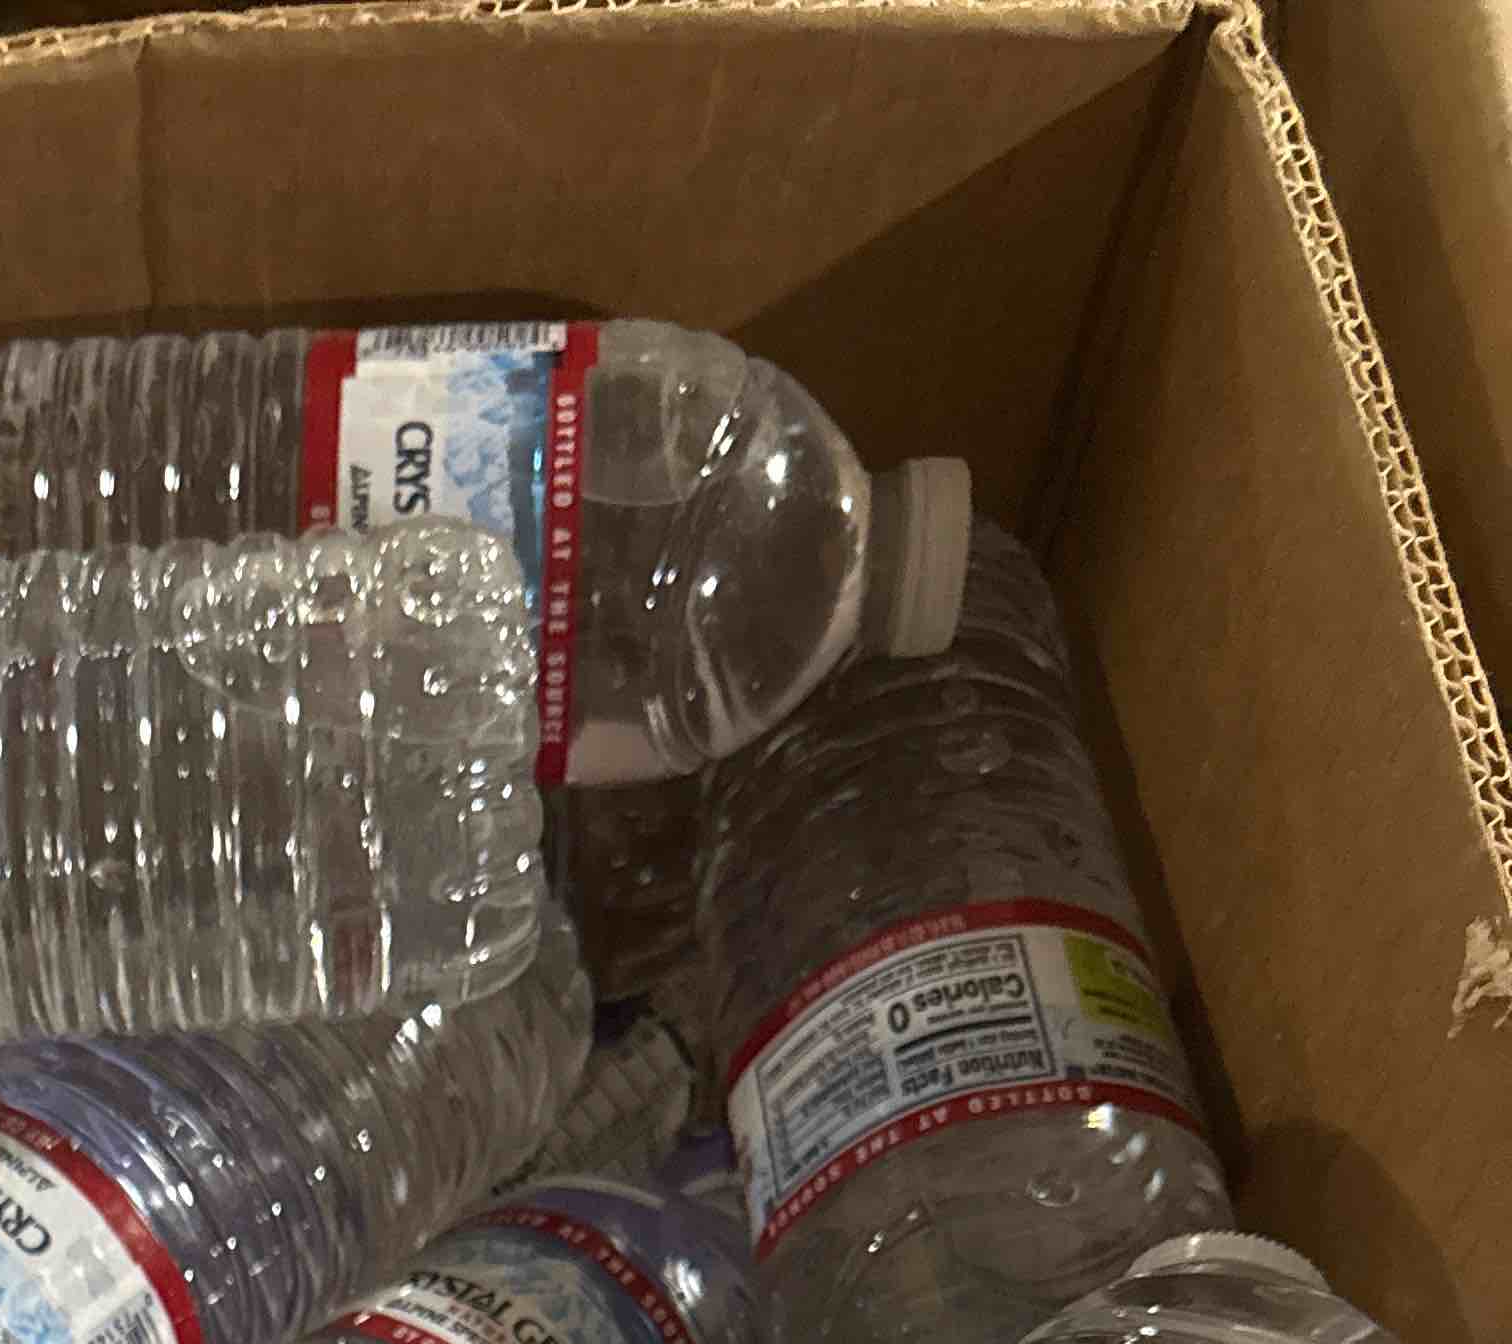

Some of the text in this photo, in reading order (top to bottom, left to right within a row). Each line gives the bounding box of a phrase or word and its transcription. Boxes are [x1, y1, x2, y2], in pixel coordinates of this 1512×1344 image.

[394, 422, 433, 516] CRYS
[914, 973, 1025, 1012] Calories
[888, 1003, 911, 1033] 0
